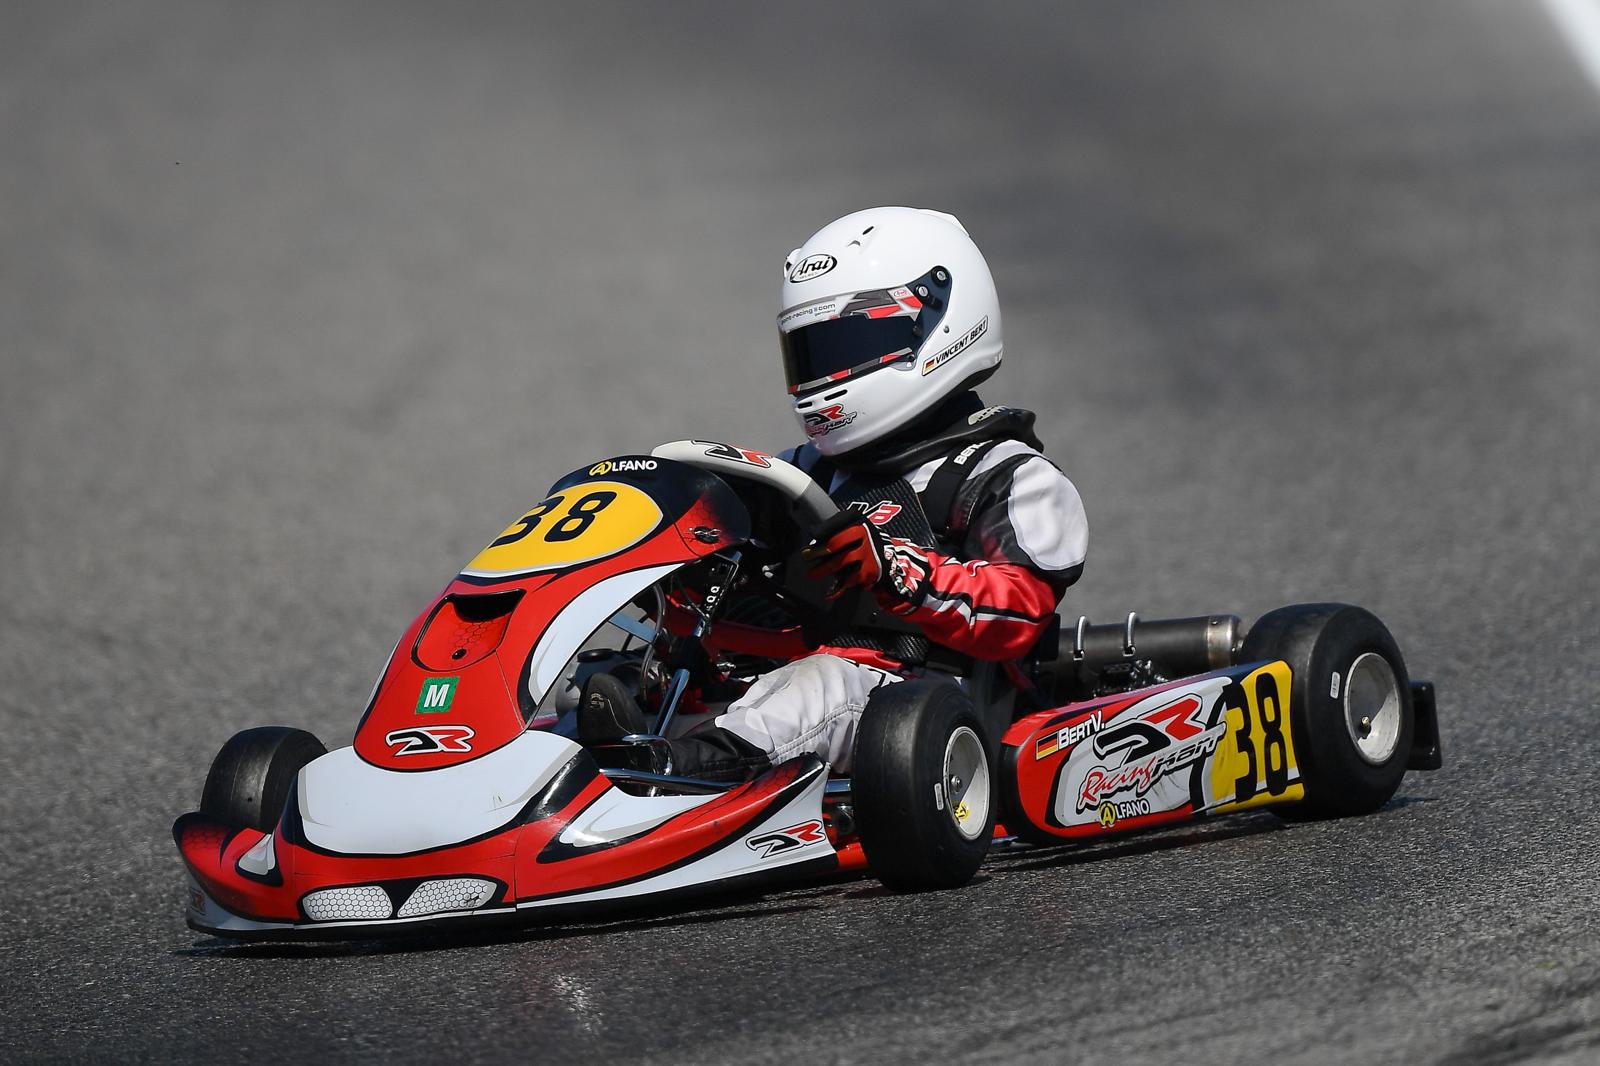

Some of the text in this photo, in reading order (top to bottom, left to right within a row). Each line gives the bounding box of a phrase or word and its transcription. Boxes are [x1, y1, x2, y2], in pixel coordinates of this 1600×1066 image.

[792, 256, 831, 279] Arai
[935, 320, 986, 364] VINCENT BERT
[589, 460, 658, 476] ALFANO
[487, 491, 617, 549] 38
[423, 683, 448, 707] M
[1226, 672, 1289, 803] 38
[1100, 799, 1150, 826] ALFANO
